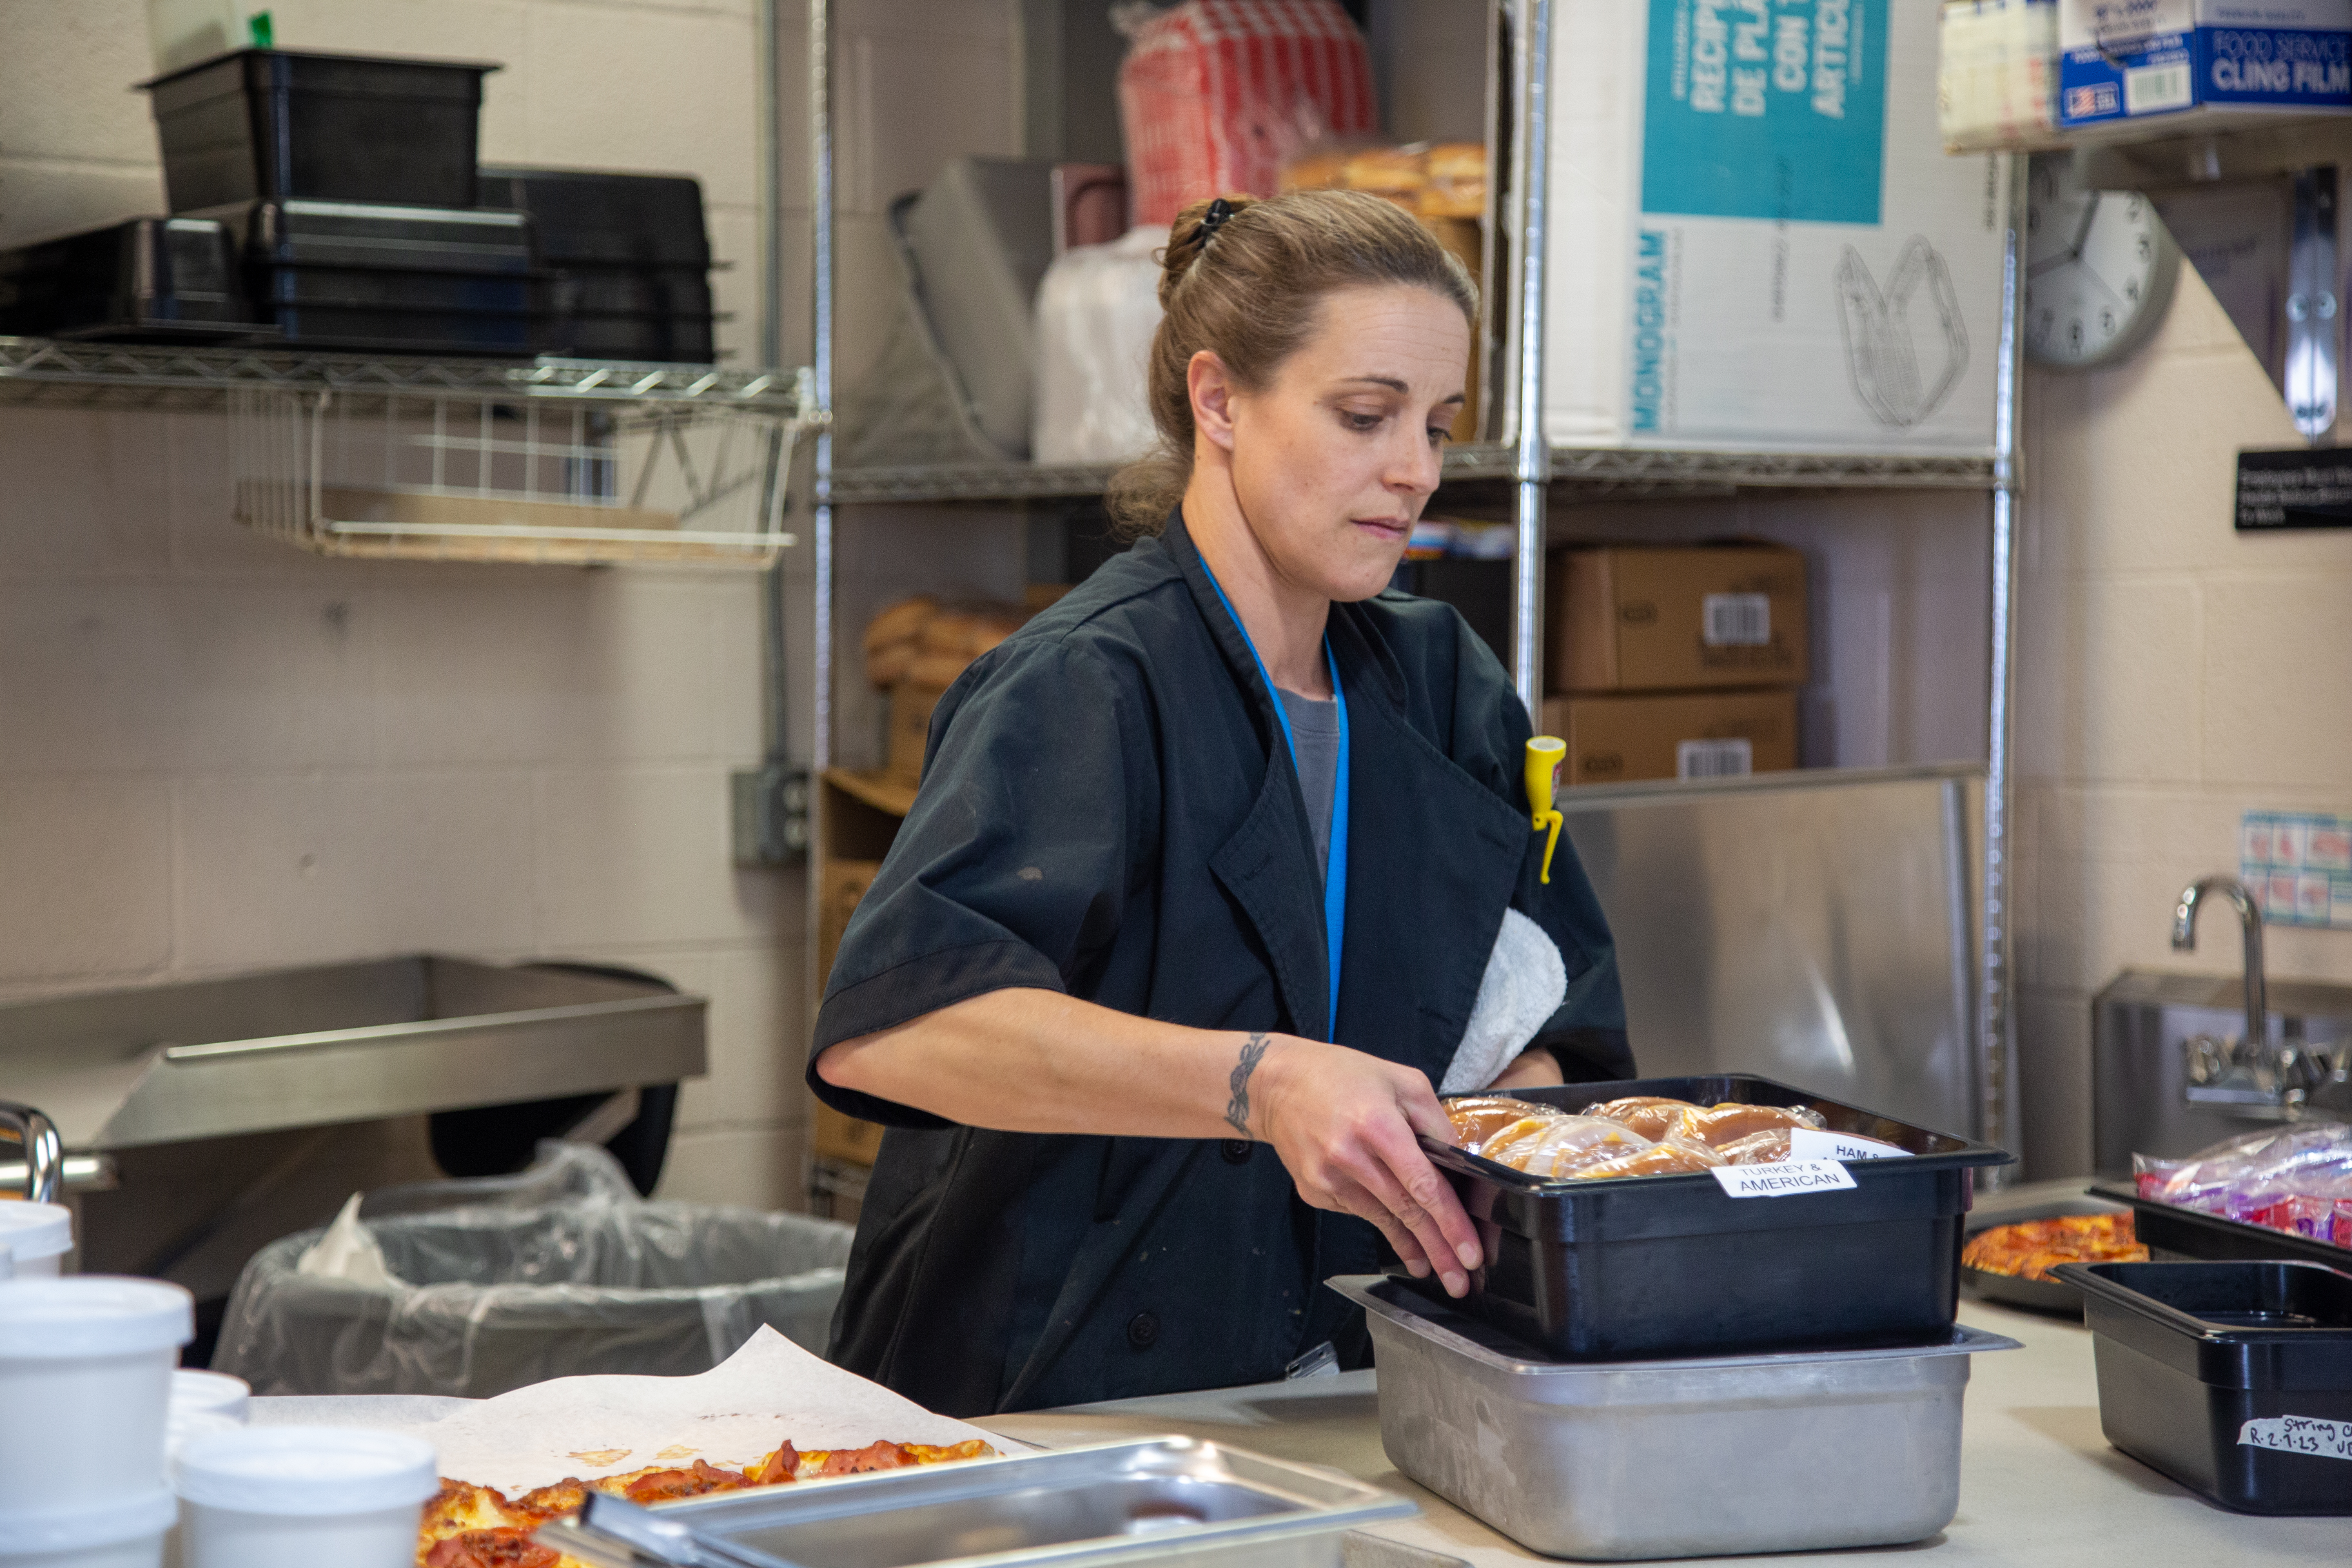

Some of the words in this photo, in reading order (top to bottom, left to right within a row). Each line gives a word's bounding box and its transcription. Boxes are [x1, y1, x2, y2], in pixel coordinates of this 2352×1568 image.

[1773, 16, 1809, 91] CON
[2213, 30, 2273, 61] FOOD
[2211, 57, 2290, 92] CLING
[2293, 60, 2351, 94] FILM
[1732, 67, 1766, 116] DE
[1633, 232, 1666, 431] MONOGRAM
[1837, 1145, 1867, 1159] HAM
[1739, 1165, 1804, 1176] TURKEY
[1740, 1174, 1841, 1191] AMERICAN
[2284, 1418, 2335, 1441] String
